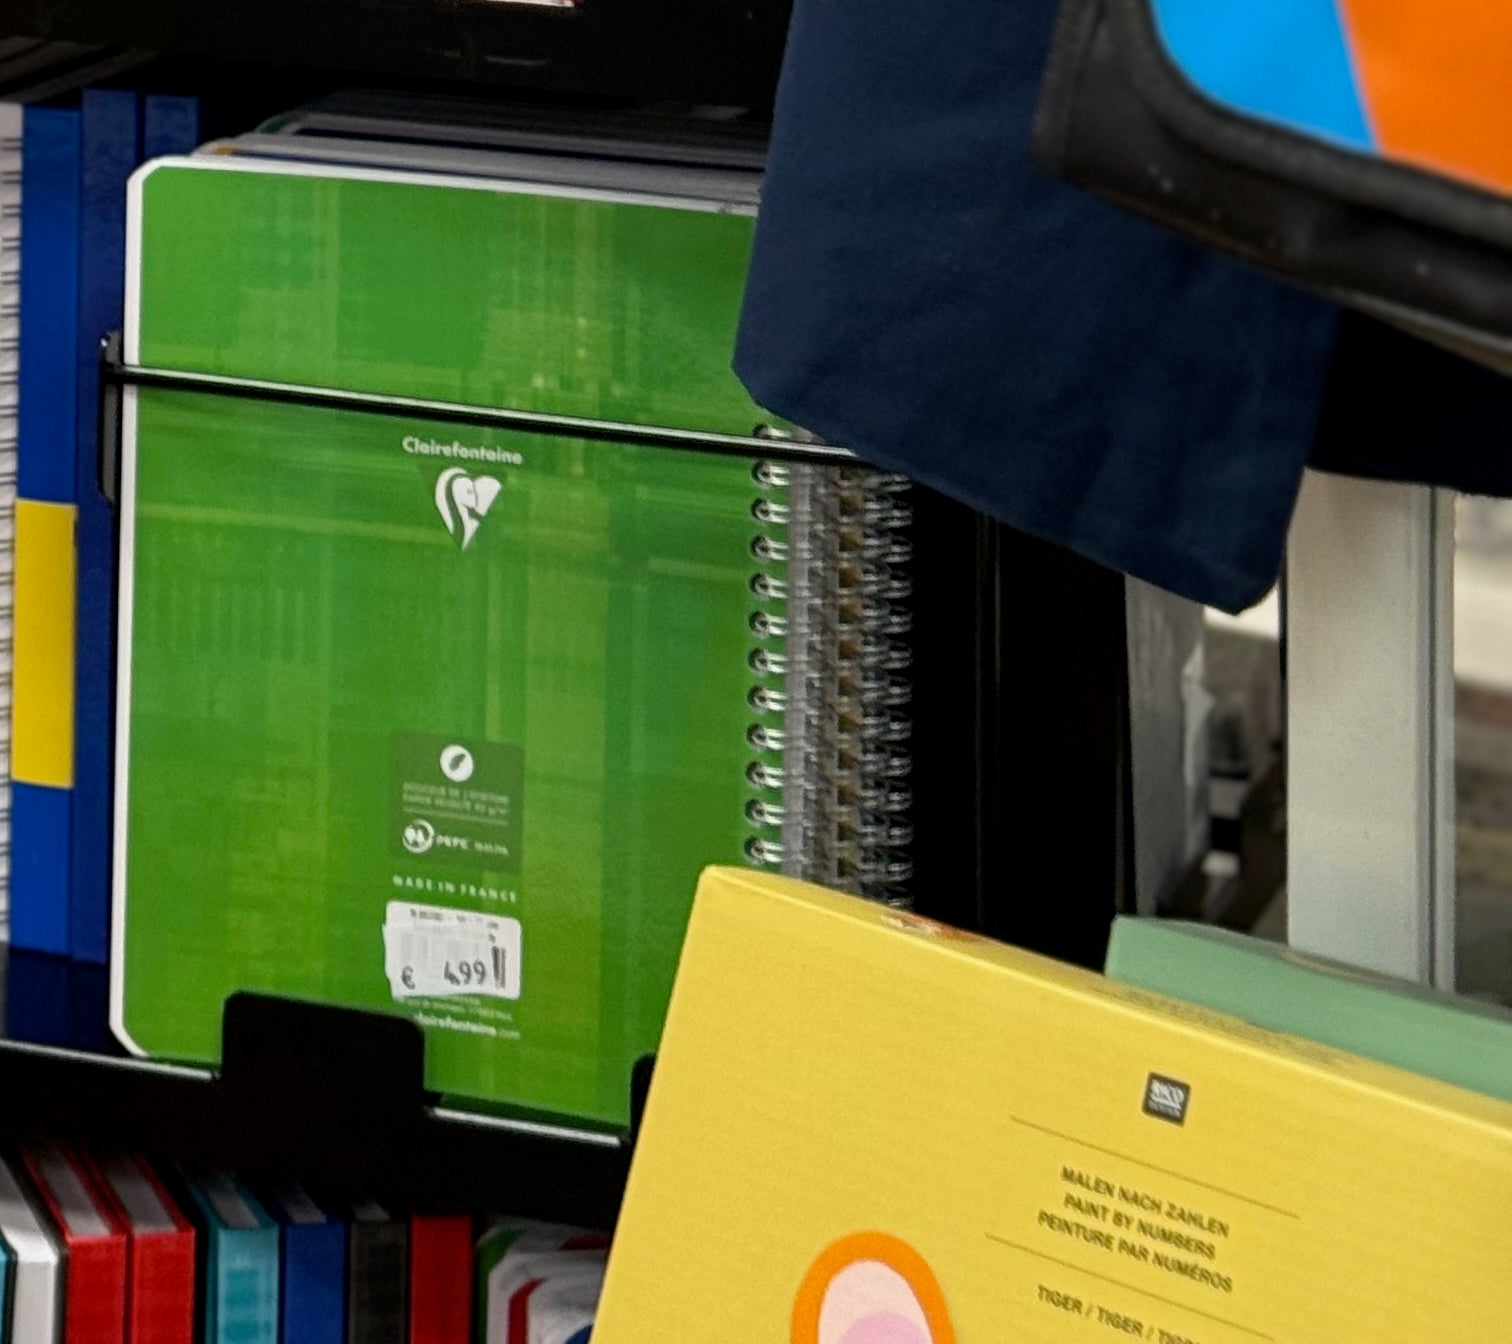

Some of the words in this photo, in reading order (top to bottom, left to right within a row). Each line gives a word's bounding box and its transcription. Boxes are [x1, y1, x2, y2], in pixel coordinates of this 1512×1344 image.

[402, 435, 522, 465] Clairefontaine
[393, 875, 433, 891] MADE
[438, 881, 455, 895] IN
[460, 883, 517, 903] FRANCE
[1061, 1166, 1115, 1198] MALEN
[1118, 1185, 1163, 1215] NACH
[1164, 1200, 1229, 1238] ZAHLEN
[1063, 1192, 1110, 1222] PAINT
[1111, 1209, 1134, 1230] BY
[1136, 1218, 1216, 1260] NUMBERS
[1038, 1209, 1115, 1252] PEINTURE
[1117, 1237, 1149, 1262] PAR
[1038, 1284, 1082, 1314] TIGER
[1097, 1305, 1143, 1338] TIGER
